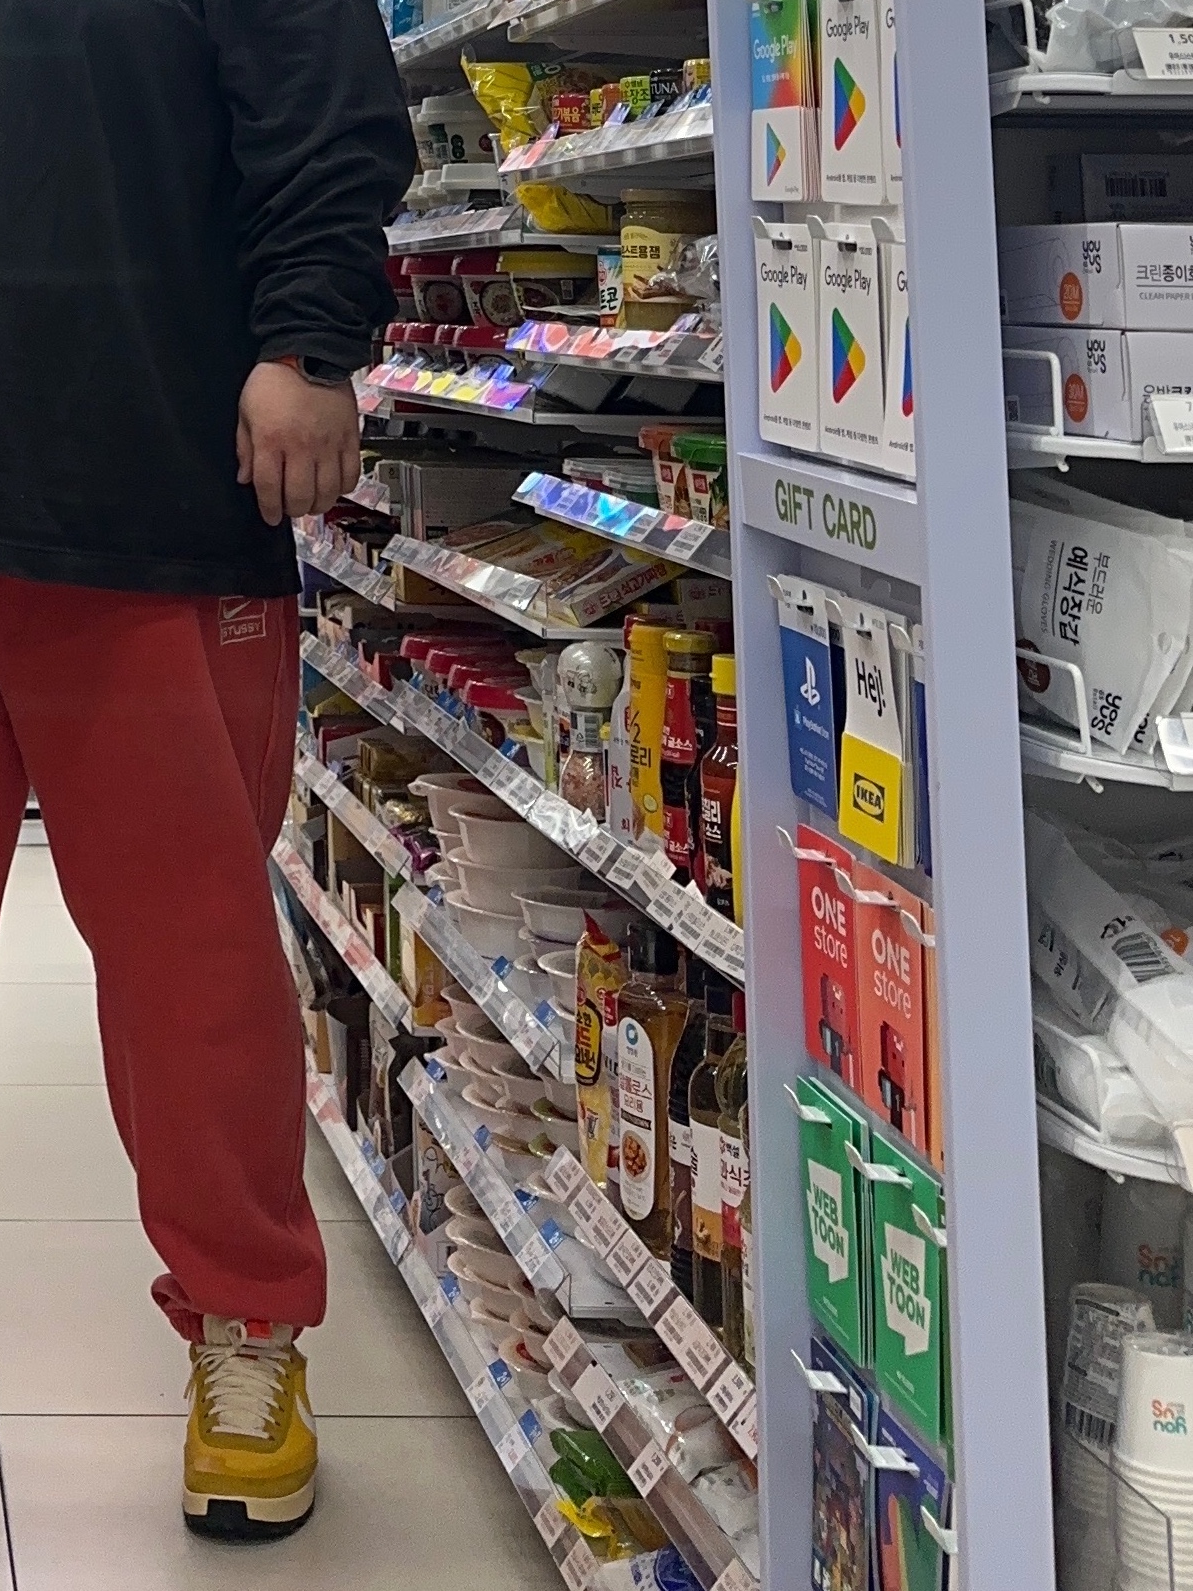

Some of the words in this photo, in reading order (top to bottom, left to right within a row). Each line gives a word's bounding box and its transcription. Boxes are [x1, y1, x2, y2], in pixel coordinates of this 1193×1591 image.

[754, 40, 781, 63] Google
[826, 17, 853, 42] Google
[854, 15, 869, 40] Play
[650, 82, 679, 95] TUNA
[761, 263, 789, 289] Google
[790, 265, 808, 291] Play
[825, 265, 853, 293] Google
[854, 269, 872, 296] Play
[775, 479, 815, 531] GIFT
[823, 493, 877, 551] CARD
[1045, 539, 1058, 593] WEDDING
[1086, 552, 1111, 615] 부드러운
[1058, 546, 1089, 647] 예식장갑
[221, 622, 261, 638] STUSSY
[855, 658, 887, 717] Hej!
[856, 784, 882, 811] IKEA
[811, 885, 847, 938] ONE
[813, 923, 849, 969] store
[871, 929, 912, 986] ONE
[872, 969, 913, 1020] store
[813, 1184, 839, 1227] WEB
[812, 1212, 845, 1259] TOON
[889, 1247, 920, 1294] WEB
[887, 1277, 927, 1328] TOON
